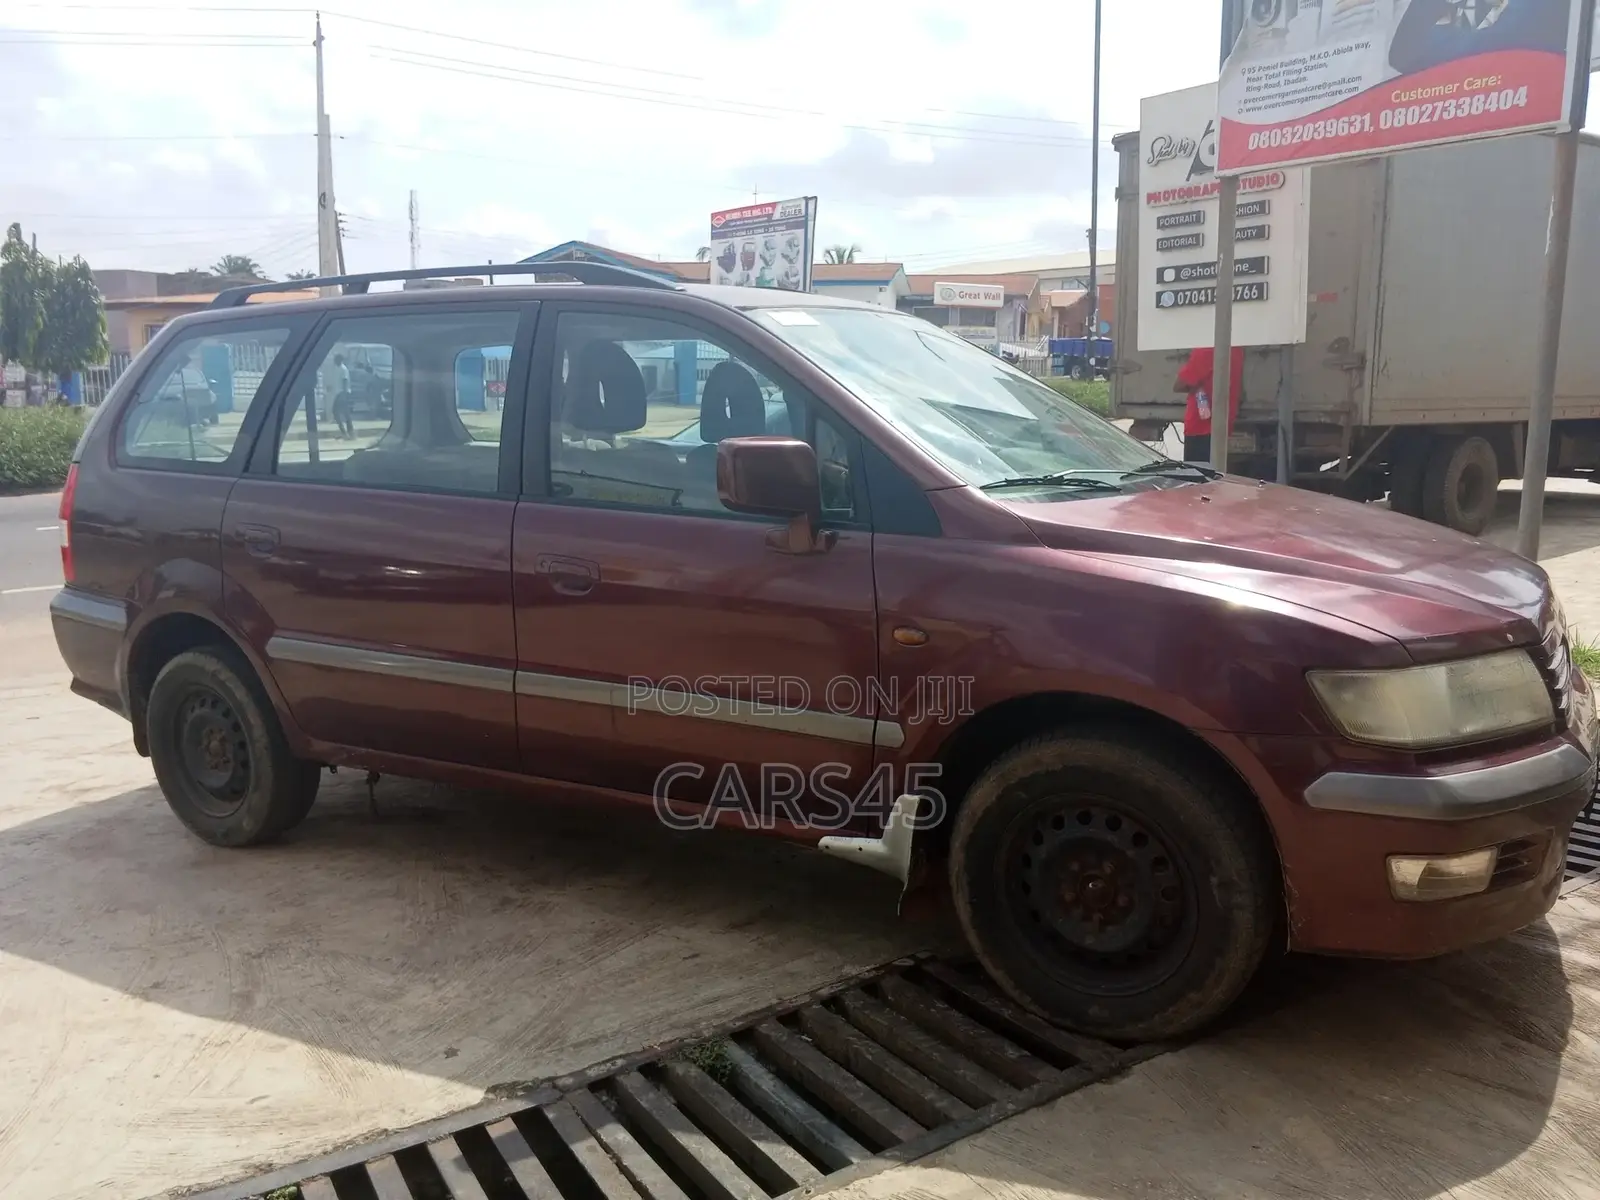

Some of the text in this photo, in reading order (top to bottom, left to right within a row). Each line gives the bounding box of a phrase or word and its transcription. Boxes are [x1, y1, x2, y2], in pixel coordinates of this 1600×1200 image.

[1332, 45, 1353, 56] Abiola
[1246, 75, 1263, 83] Near
[1264, 70, 1281, 80] Total
[1283, 66, 1302, 77] Filling
[1391, 74, 1502, 103] Customer Care:
[1248, 85, 1528, 150] 08032039631, 08027338404
[1147, 181, 1221, 205] PHOTOGRAP
[1235, 203, 1260, 216] SHION
[1159, 213, 1197, 227] PORTRAIT
[1235, 228, 1257, 240] AUTY
[1158, 236, 1197, 249] EDITORIAL
[958, 290, 1001, 301] Great Wall
